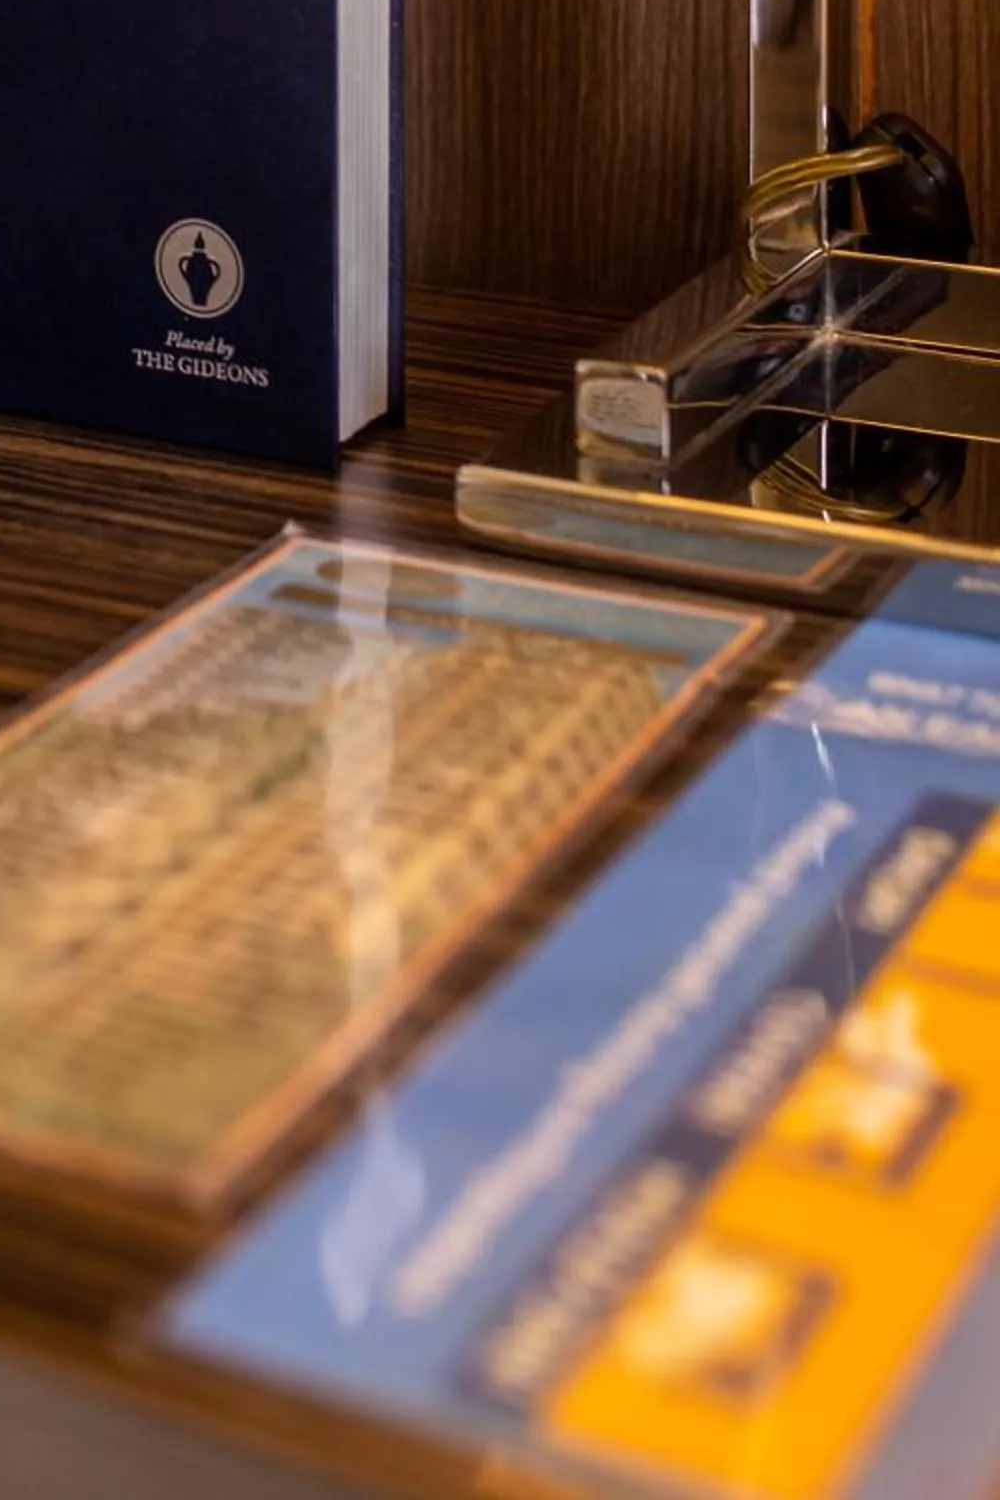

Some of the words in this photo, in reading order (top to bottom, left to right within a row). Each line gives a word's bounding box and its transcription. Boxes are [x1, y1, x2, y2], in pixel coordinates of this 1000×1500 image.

[164, 329, 216, 352] Placed
[217, 337, 236, 360] by
[131, 348, 175, 371] THE
[177, 357, 270, 388] GIDEONS
